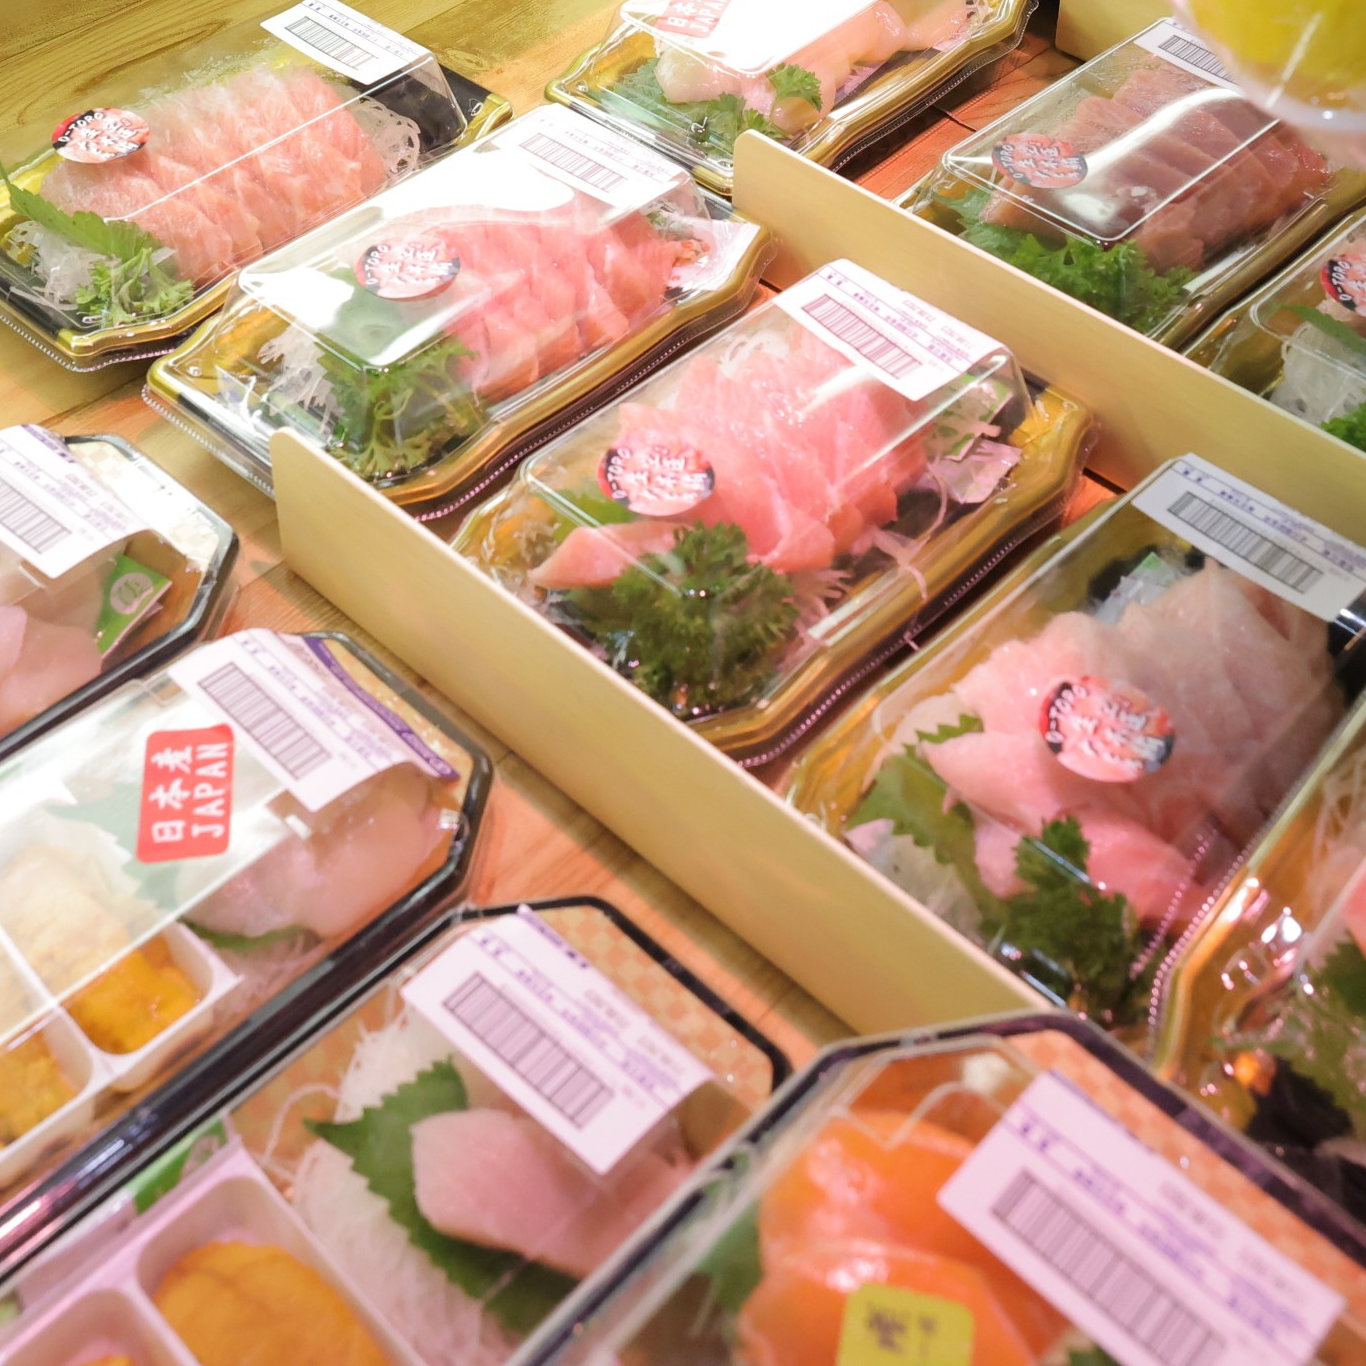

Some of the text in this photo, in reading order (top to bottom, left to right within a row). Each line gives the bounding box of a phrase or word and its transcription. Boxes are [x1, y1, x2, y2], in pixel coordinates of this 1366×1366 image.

[58, 114, 104, 142] O-TORO
[1001, 144, 1024, 179] O-TORO
[364, 245, 390, 285] O-TORO
[1332, 260, 1352, 302] O-TORO
[606, 449, 630, 499] O-TORO
[1045, 686, 1087, 745] O-TORO
[149, 744, 191, 844] 日本産
[191, 742, 230, 839] JAPAN
